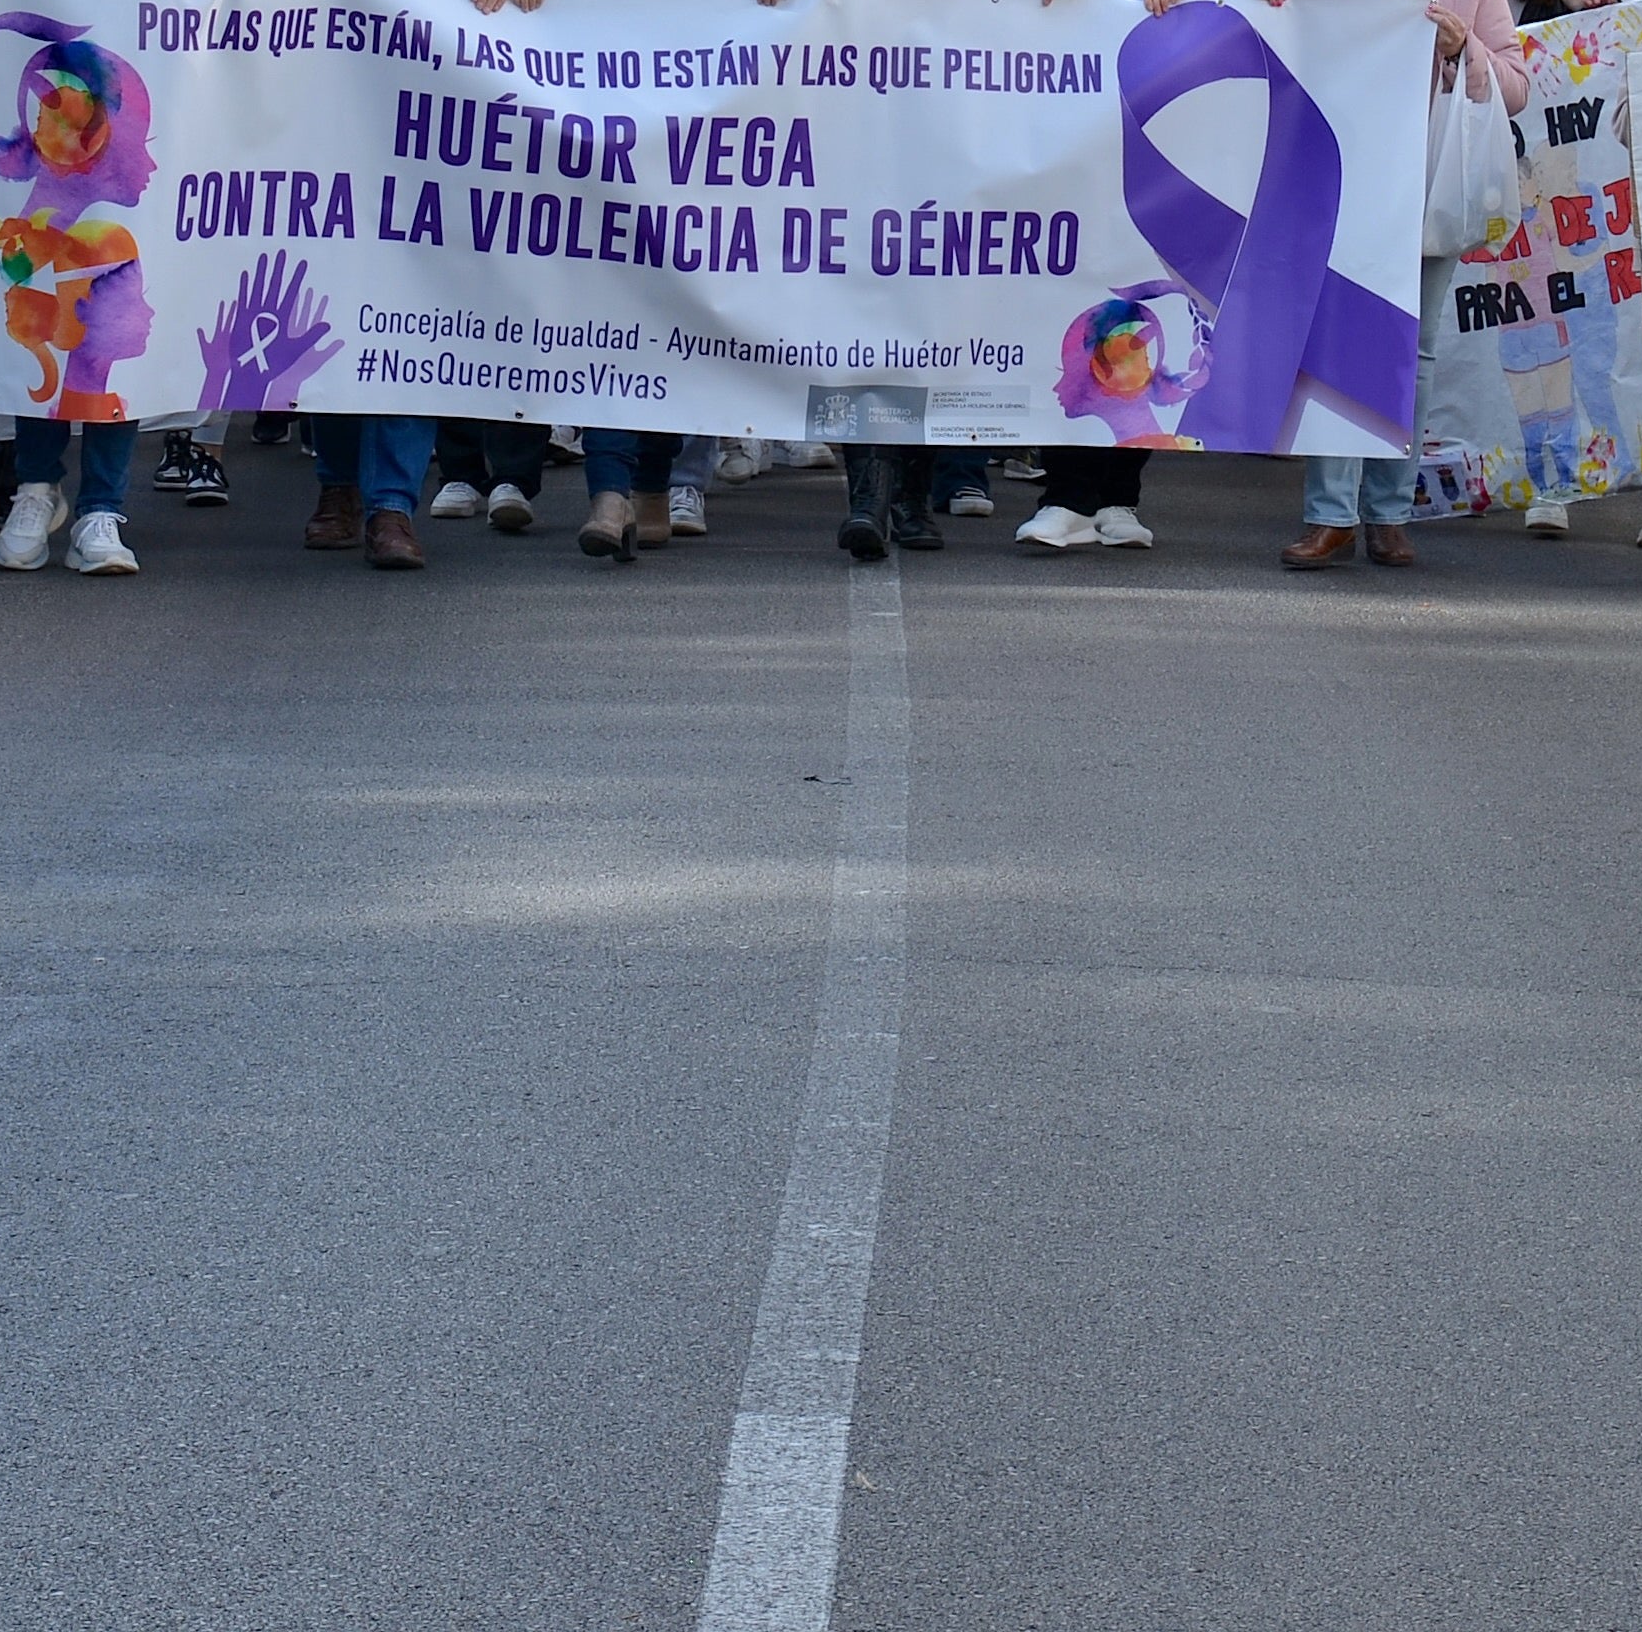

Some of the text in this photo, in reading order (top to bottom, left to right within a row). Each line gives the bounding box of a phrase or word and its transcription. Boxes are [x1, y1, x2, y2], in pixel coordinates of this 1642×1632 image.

[138, 2, 1102, 95] POR LAS QUE ESTÁN, LAS QUE NO ESTÁN Y LAS QUE PELIGRAN
[393, 90, 815, 187] HUÉTOR VEGA
[1544, 96, 1605, 148] HAY
[175, 170, 1080, 277] CONTRA LA VIOLENCIA DE GÉNERO
[1550, 195, 1597, 247] DE
[1455, 281, 1536, 333] PARA
[1547, 272, 1586, 314] EL
[359, 304, 484, 342] Concejalía
[495, 315, 523, 344] de
[533, 320, 640, 353] Igualdad
[666, 326, 838, 368] Ayuntamiento
[847, 338, 875, 368] de
[884, 338, 962, 368] Huétor
[969, 338, 1024, 372] Vega
[357, 348, 668, 401] #NosQueremosVivas
